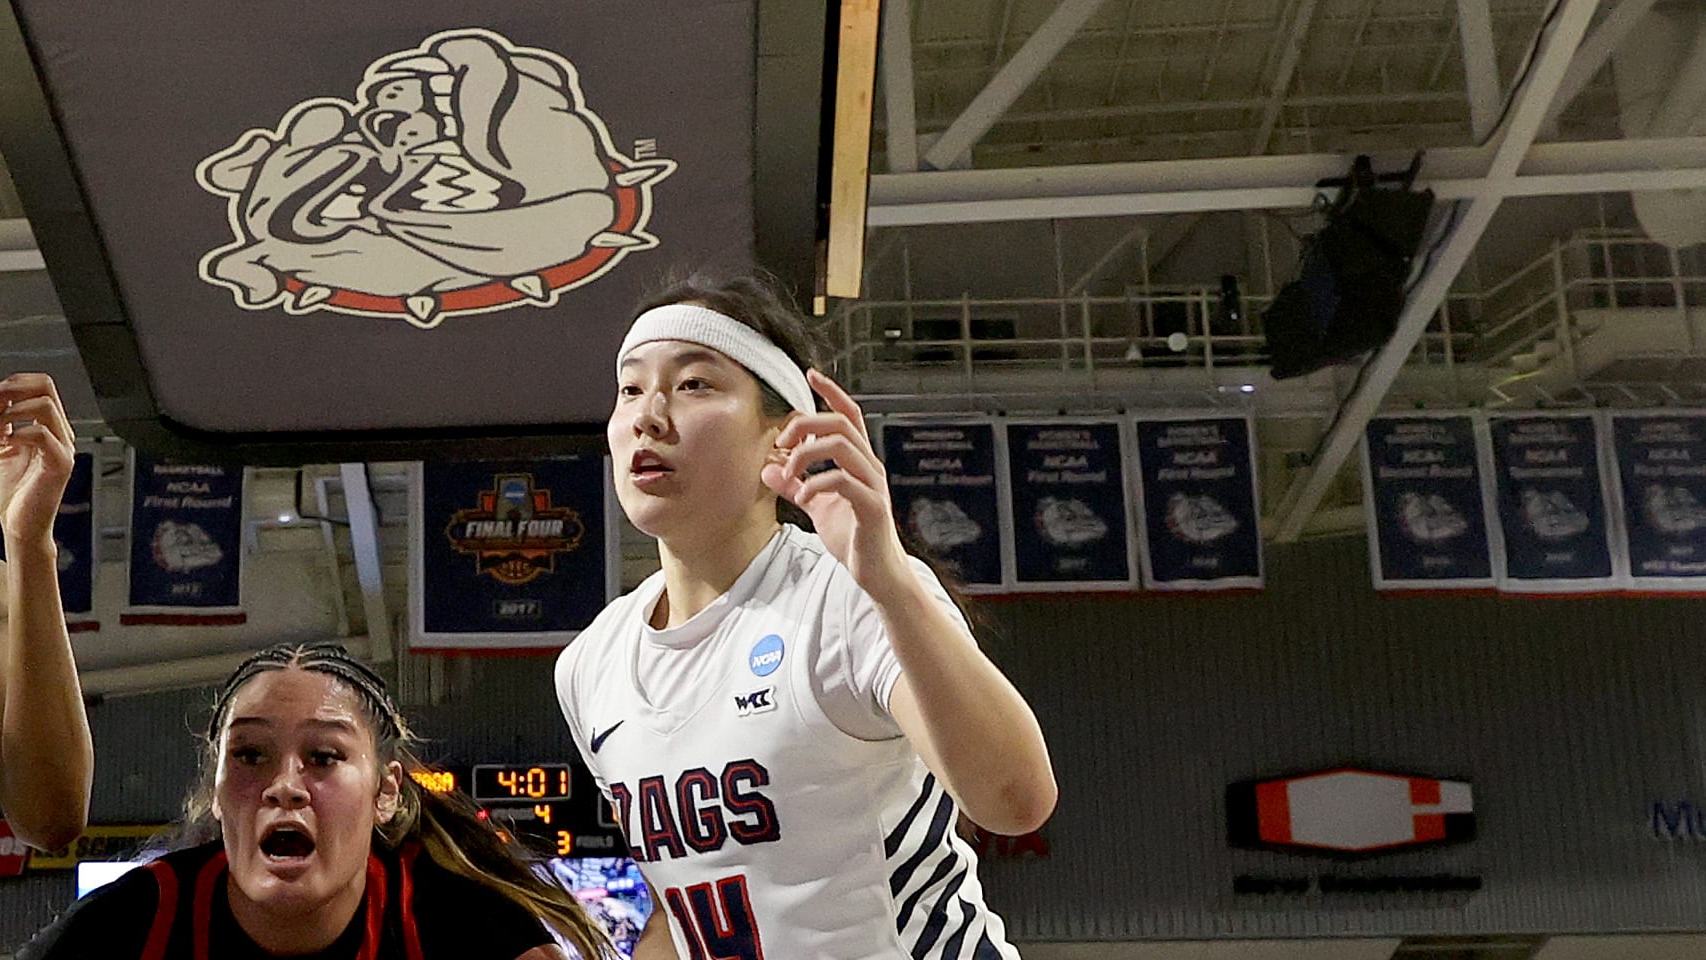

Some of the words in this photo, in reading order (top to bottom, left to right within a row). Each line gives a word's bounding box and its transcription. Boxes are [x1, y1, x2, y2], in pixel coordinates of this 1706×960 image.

[635, 138, 656, 160] TM
[153, 465, 224, 476] BASKETBALL
[165, 482, 212, 493] NCAA
[144, 496, 178, 508] First
[181, 495, 233, 508] Round
[465, 520, 513, 538] FINAL
[517, 519, 564, 538] FOUR
[499, 602, 538, 616] 2017
[752, 649, 782, 669] NCAA
[734, 689, 774, 710] WCC
[497, 767, 567, 798] 4:01
[534, 804, 550, 825] 4
[611, 758, 780, 863] ZAGS
[557, 830, 571, 855] 3
